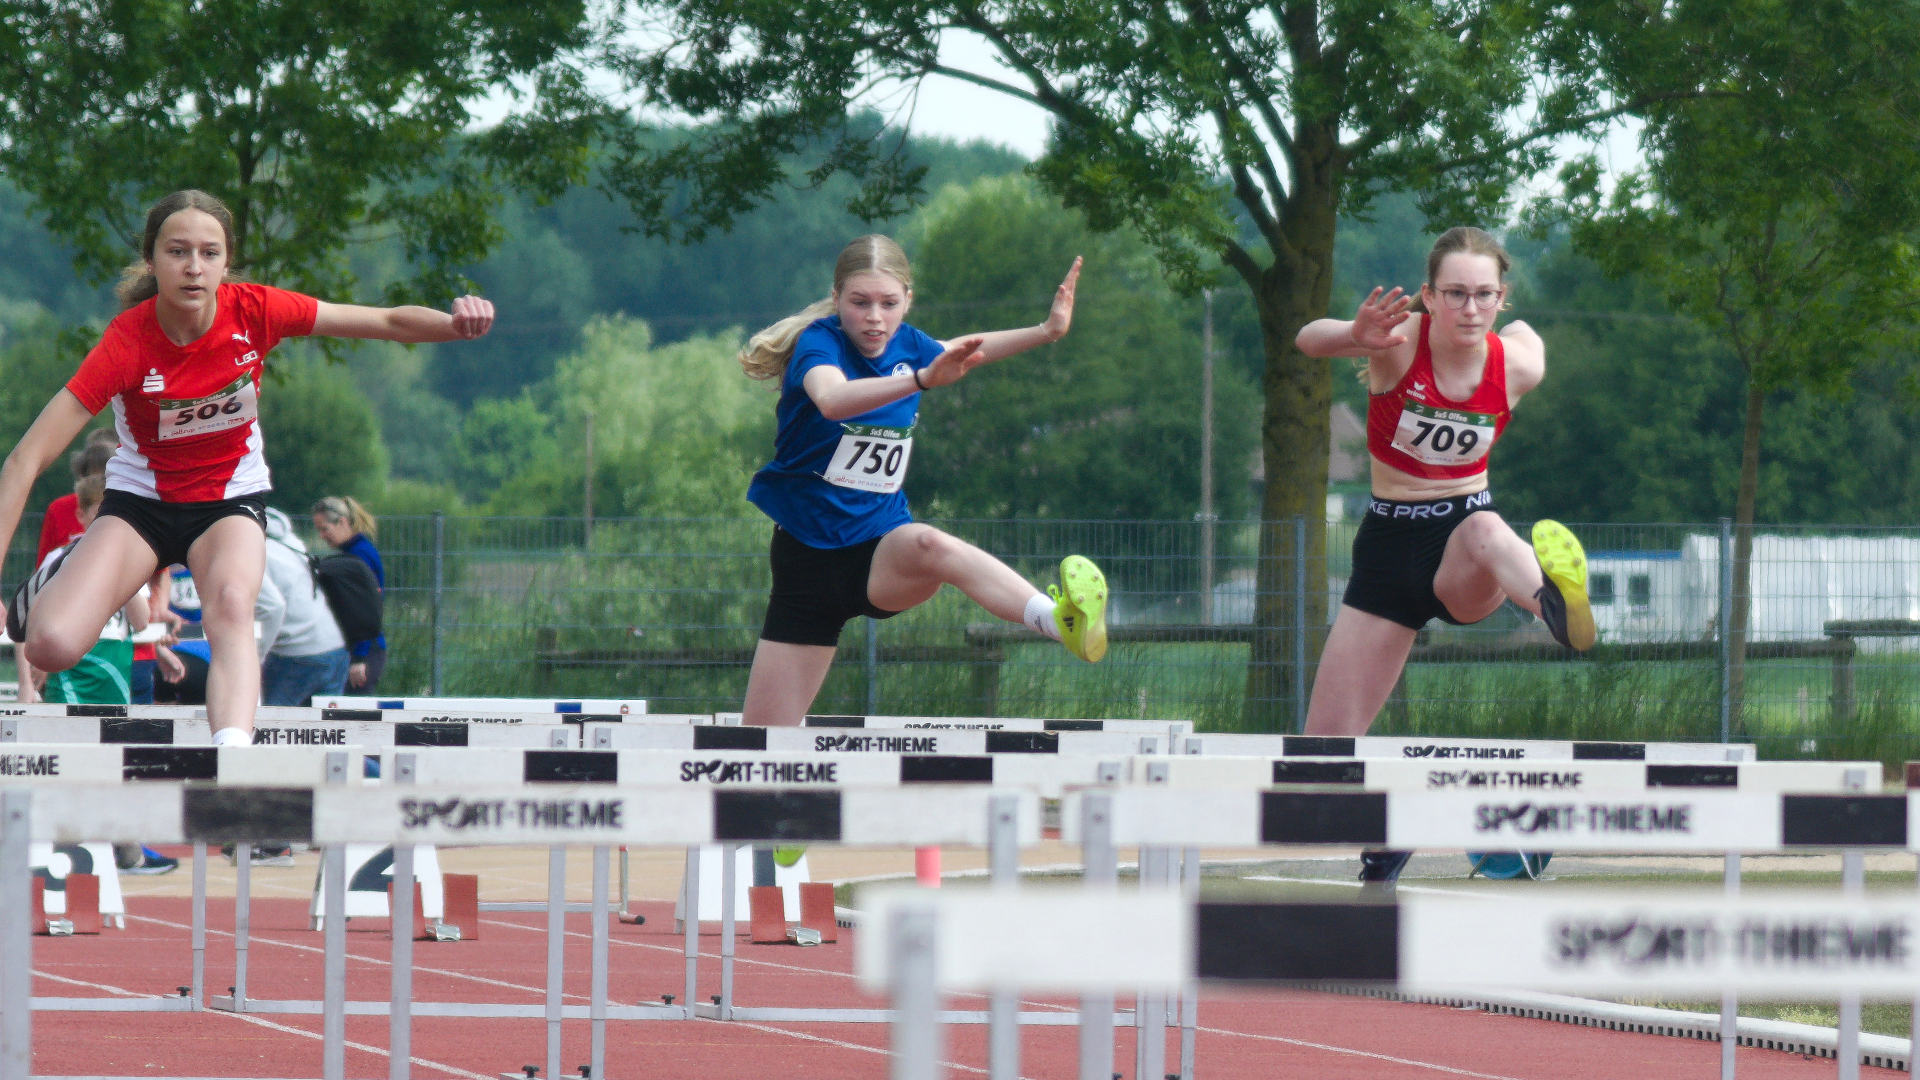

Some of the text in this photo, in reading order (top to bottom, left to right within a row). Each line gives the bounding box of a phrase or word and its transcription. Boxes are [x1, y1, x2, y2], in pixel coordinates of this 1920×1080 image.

[174, 395, 244, 426] 506
[1434, 410, 1447, 419] SuS
[870, 428, 882, 436] SuS
[1411, 420, 1479, 456] 709
[844, 440, 903, 477] 750
[1393, 501, 1454, 520] PRO
[680, 760, 838, 785] SPORT-THIEME
[401, 797, 625, 831] SPORT-THIEME
[1475, 801, 1692, 834] SPORT-THIEME
